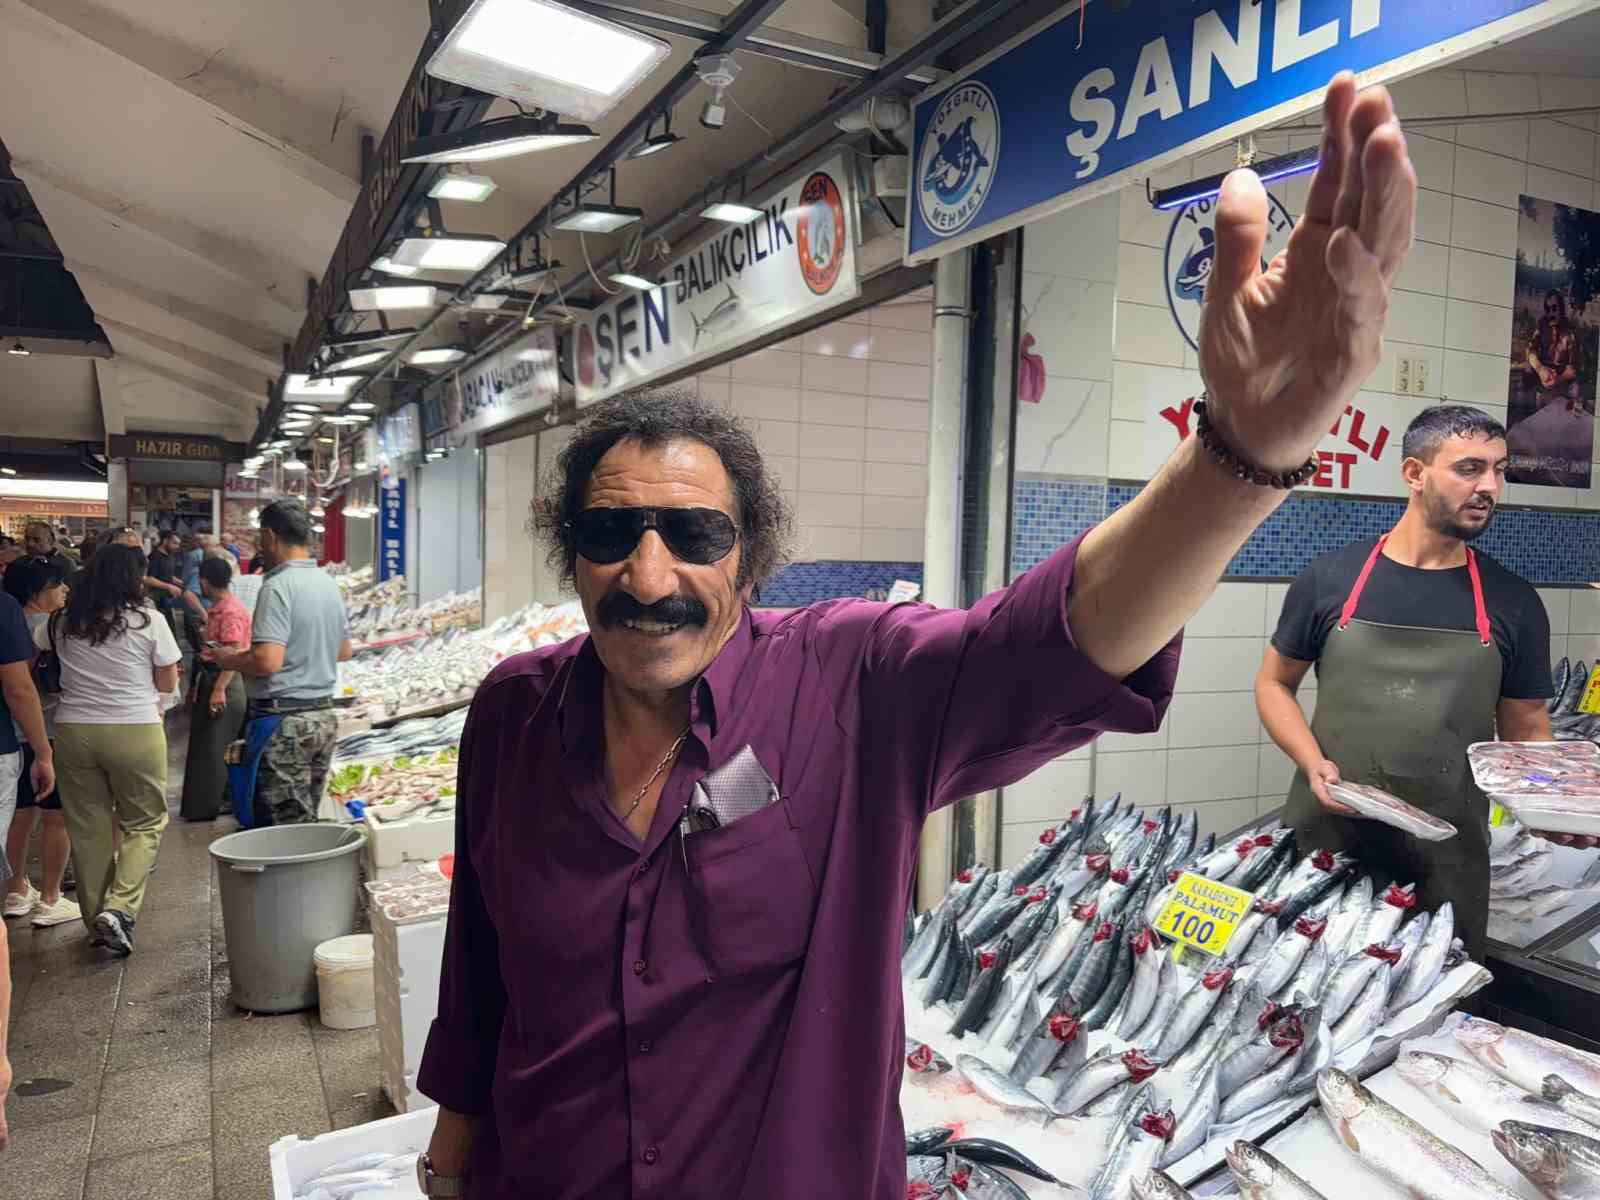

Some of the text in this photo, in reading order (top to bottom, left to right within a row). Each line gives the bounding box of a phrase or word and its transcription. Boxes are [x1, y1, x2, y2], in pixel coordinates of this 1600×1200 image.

[928, 90, 988, 134] YOZGATLI
[931, 183, 982, 227] MEHMET
[596, 198, 793, 387] ŞEN BALIKÇILIK
[136, 439, 182, 456] HAZIR
[1175, 891, 1239, 923] PALAMUT
[1172, 911, 1214, 944] 100
